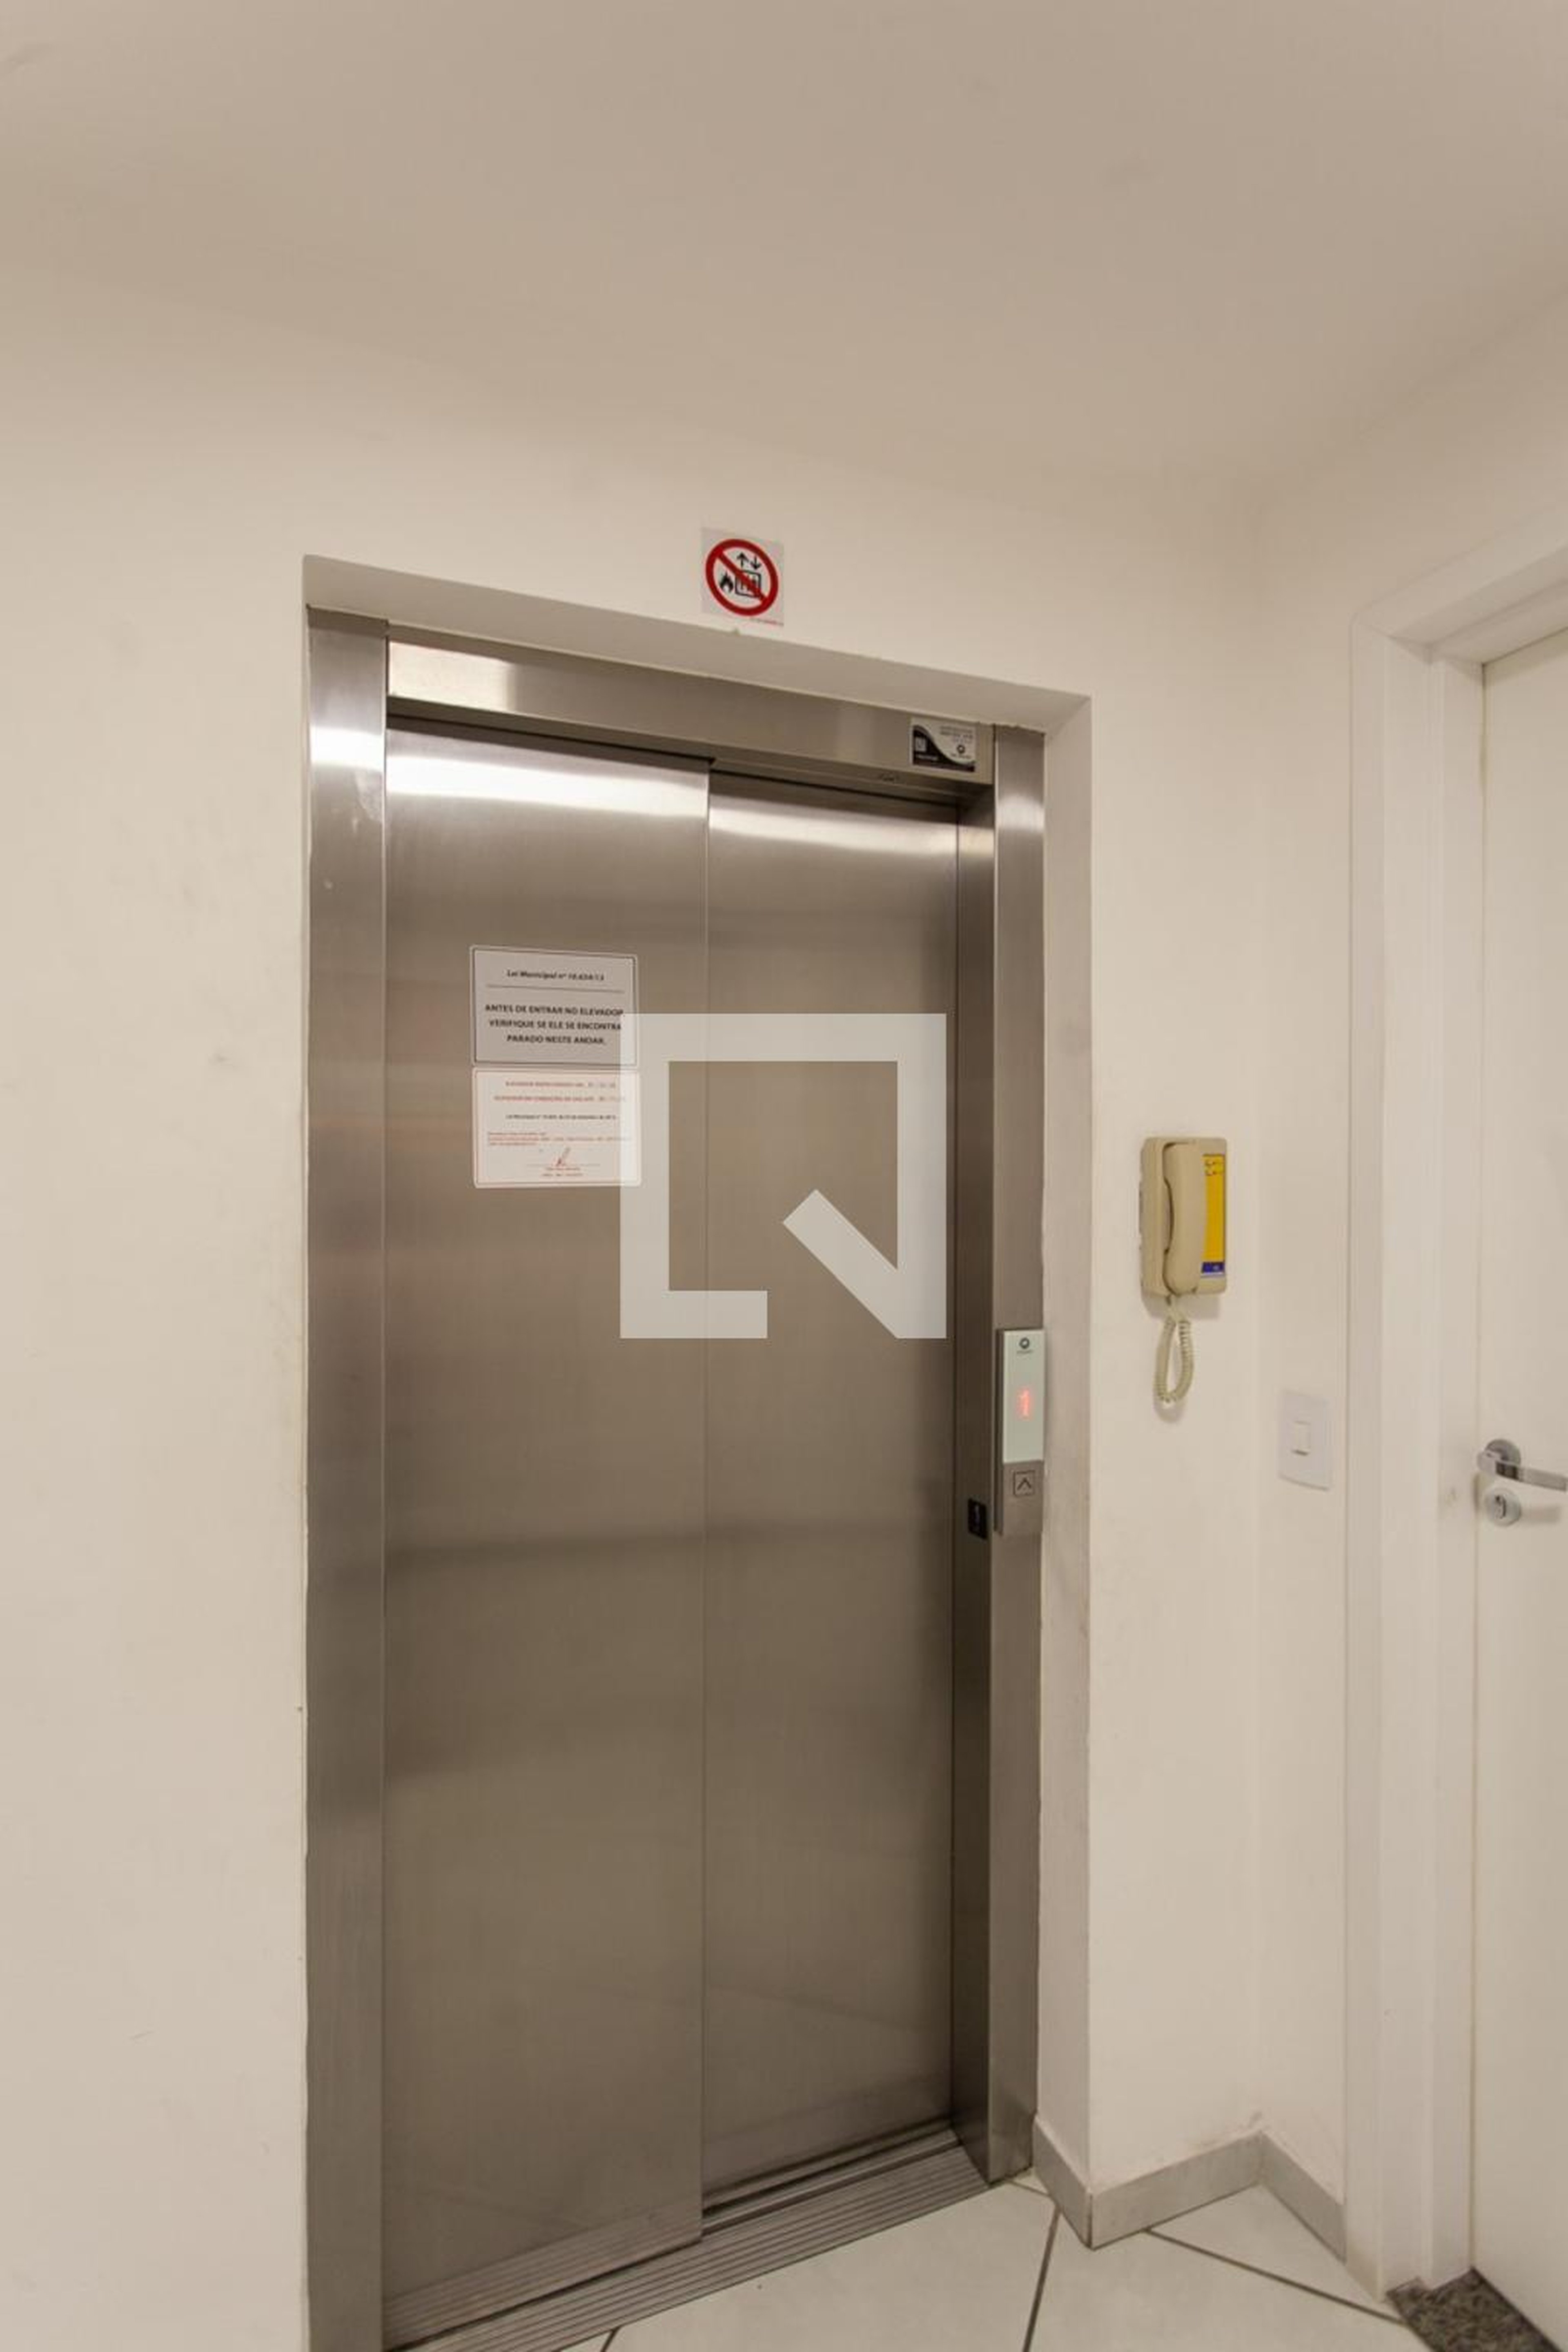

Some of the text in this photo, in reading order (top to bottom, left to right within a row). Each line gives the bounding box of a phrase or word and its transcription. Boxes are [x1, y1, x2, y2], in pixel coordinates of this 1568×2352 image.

[520, 971, 557, 980] Municipal
[485, 1004, 513, 1013] ANTES
[515, 1005, 527, 1013] DE
[529, 1006, 563, 1014] ENTRAR
[490, 1019, 534, 1028] VERIFIQUE
[548, 1021, 563, 1029] ELE
[507, 1034, 543, 1043] PARADO
